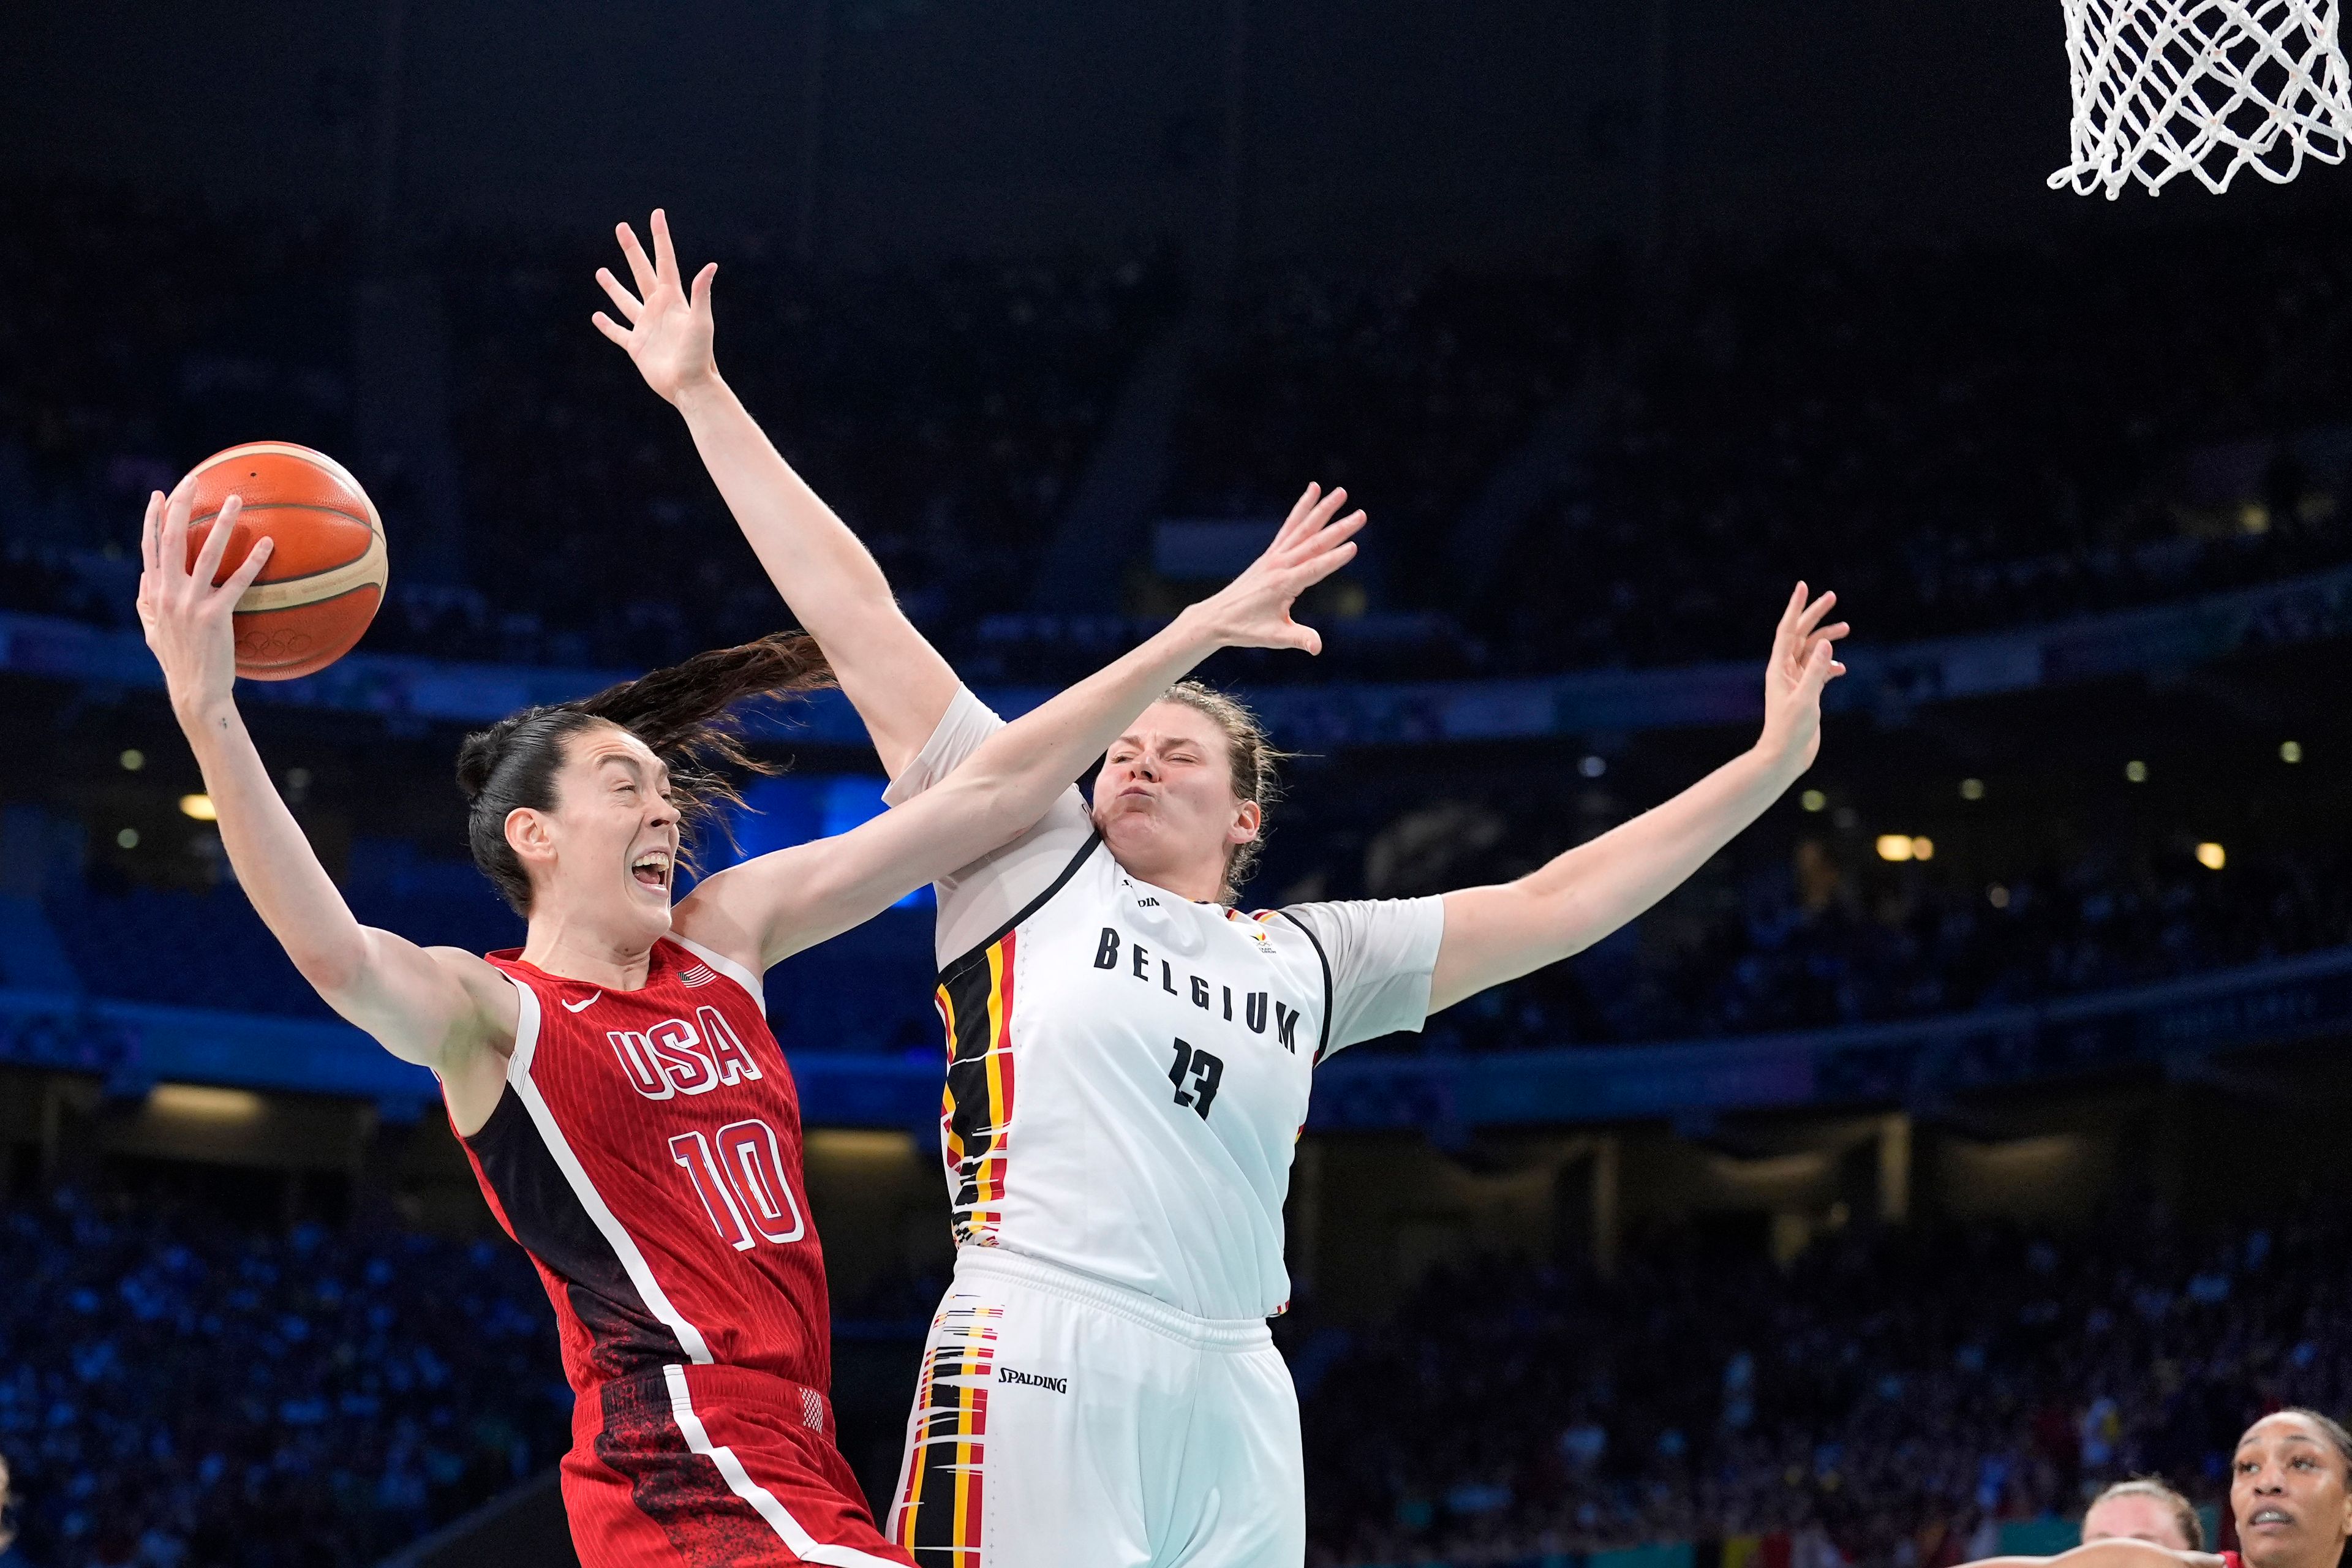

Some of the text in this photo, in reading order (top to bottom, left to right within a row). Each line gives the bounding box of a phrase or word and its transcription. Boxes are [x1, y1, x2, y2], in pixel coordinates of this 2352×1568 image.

[1094, 927, 1300, 1054] BELGIUM
[606, 1005, 763, 1100] USA
[1169, 1038, 1224, 1120] 13
[668, 1119, 805, 1251] 10
[998, 1367, 1067, 1395] SPALDING
